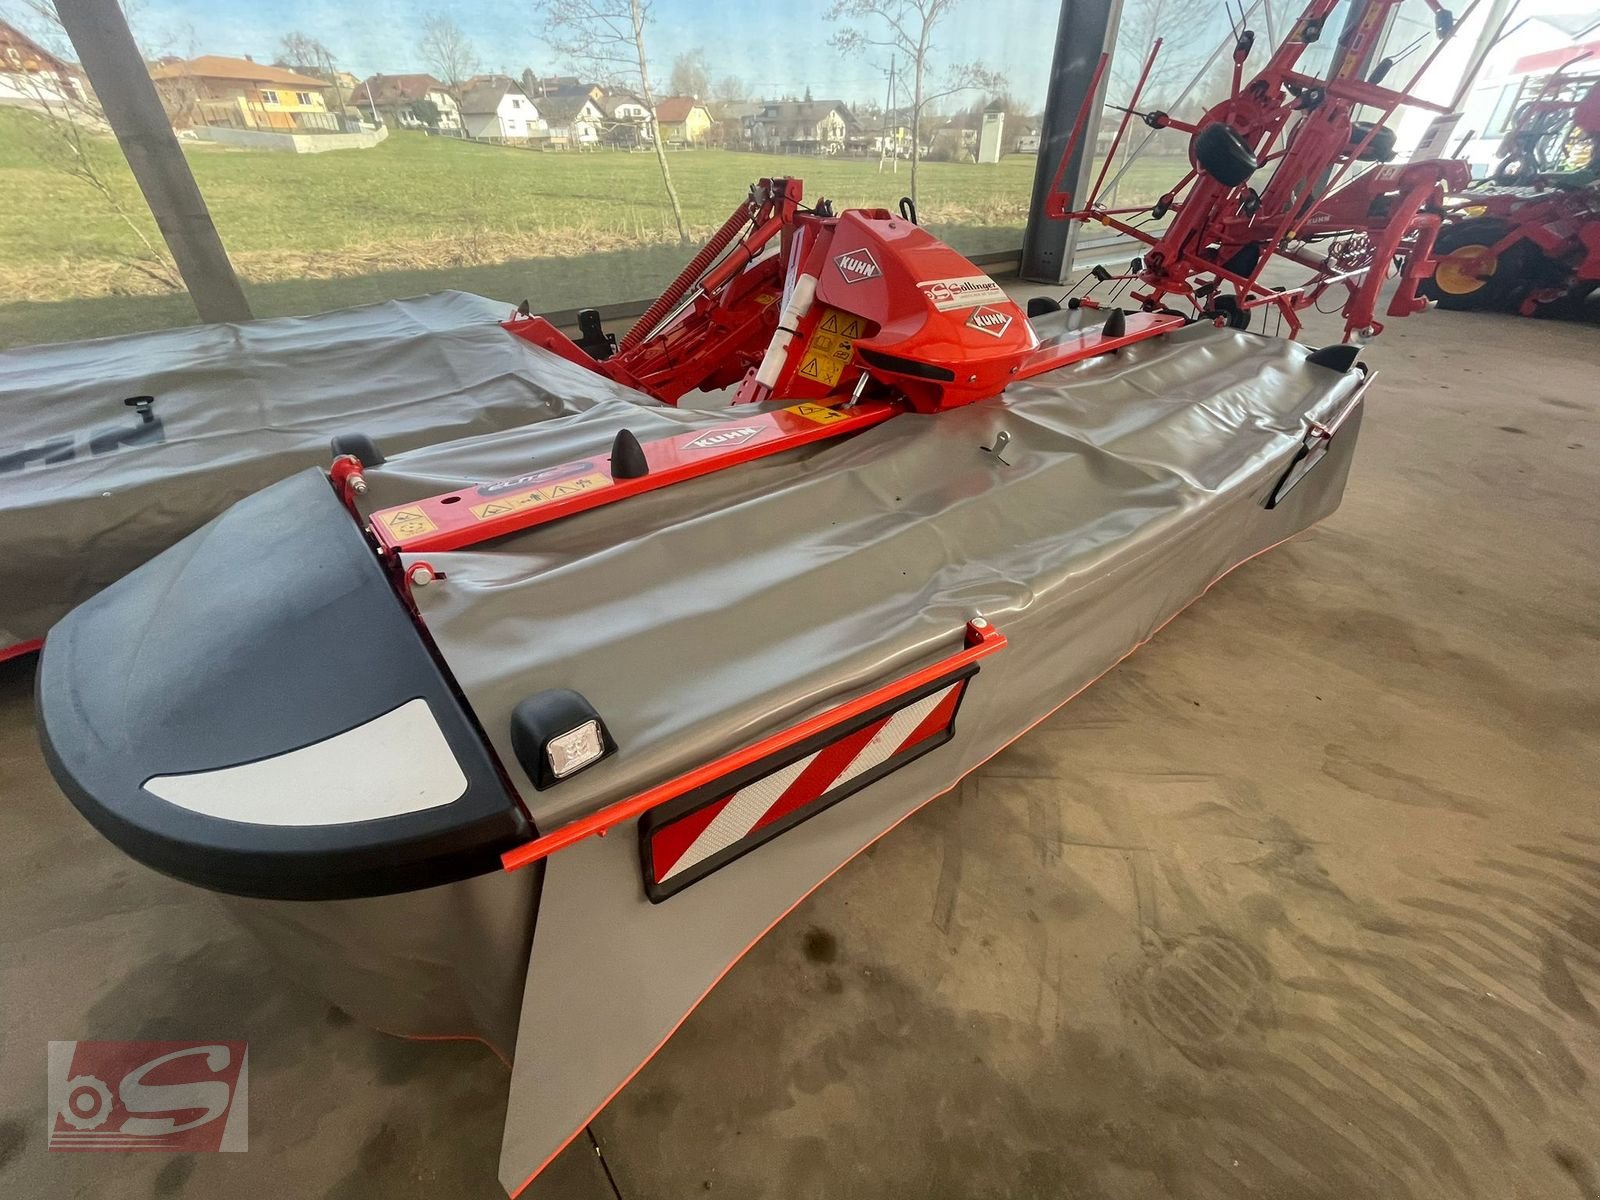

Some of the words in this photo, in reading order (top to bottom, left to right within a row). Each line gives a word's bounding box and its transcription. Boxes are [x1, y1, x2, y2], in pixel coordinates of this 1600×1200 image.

[840, 256, 876, 277] KUHN
[973, 312, 1007, 327] KUHN
[693, 427, 758, 448] KUHN
